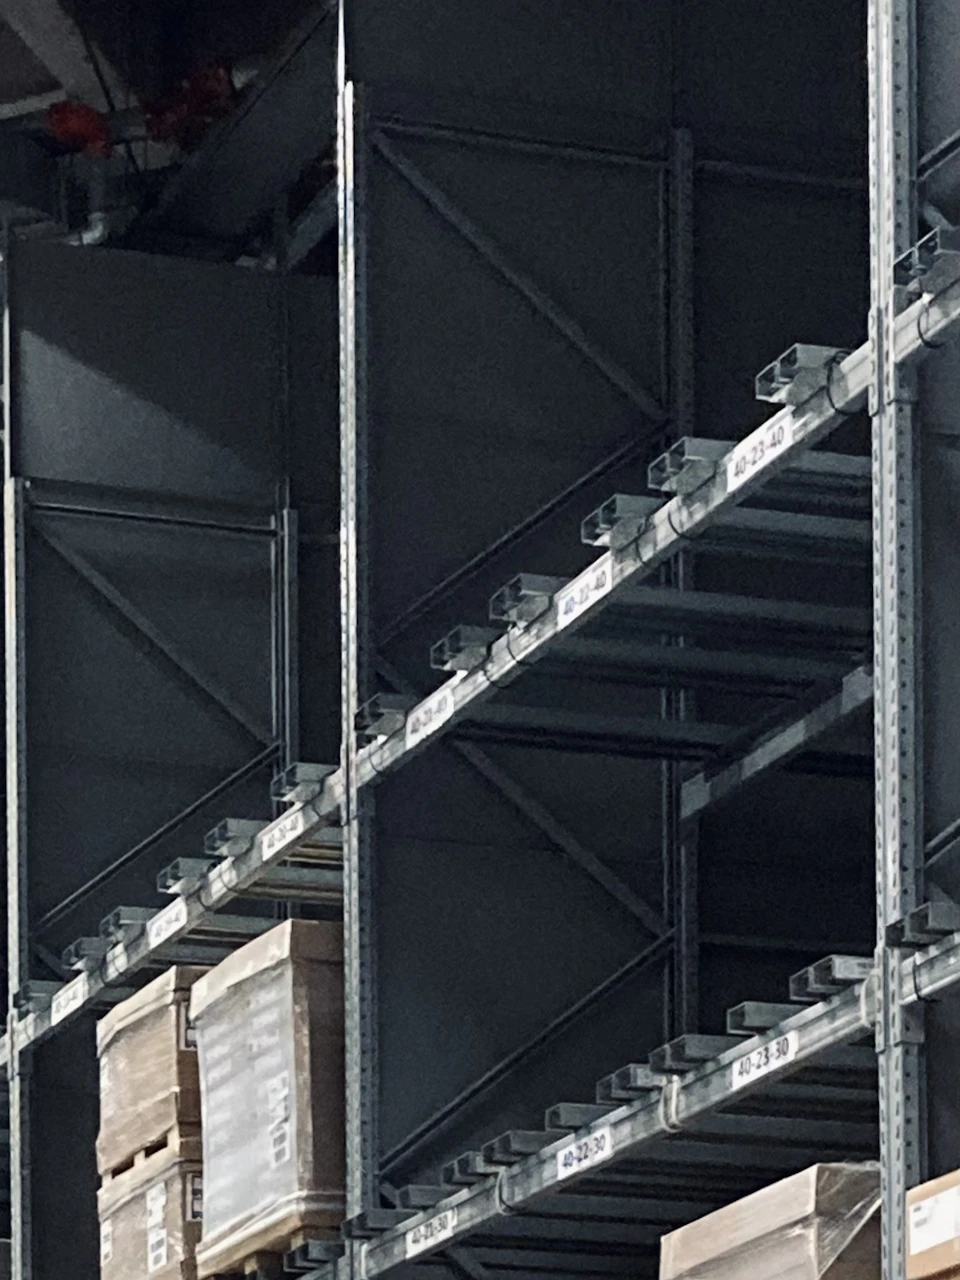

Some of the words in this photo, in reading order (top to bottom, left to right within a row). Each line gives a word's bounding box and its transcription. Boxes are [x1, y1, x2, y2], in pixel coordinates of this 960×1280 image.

[734, 426, 786, 479] 40-23-40
[563, 570, 607, 616] 40-22-40
[738, 1036, 789, 1077] 40-23-30
[562, 1133, 606, 1169] 40-22-30
